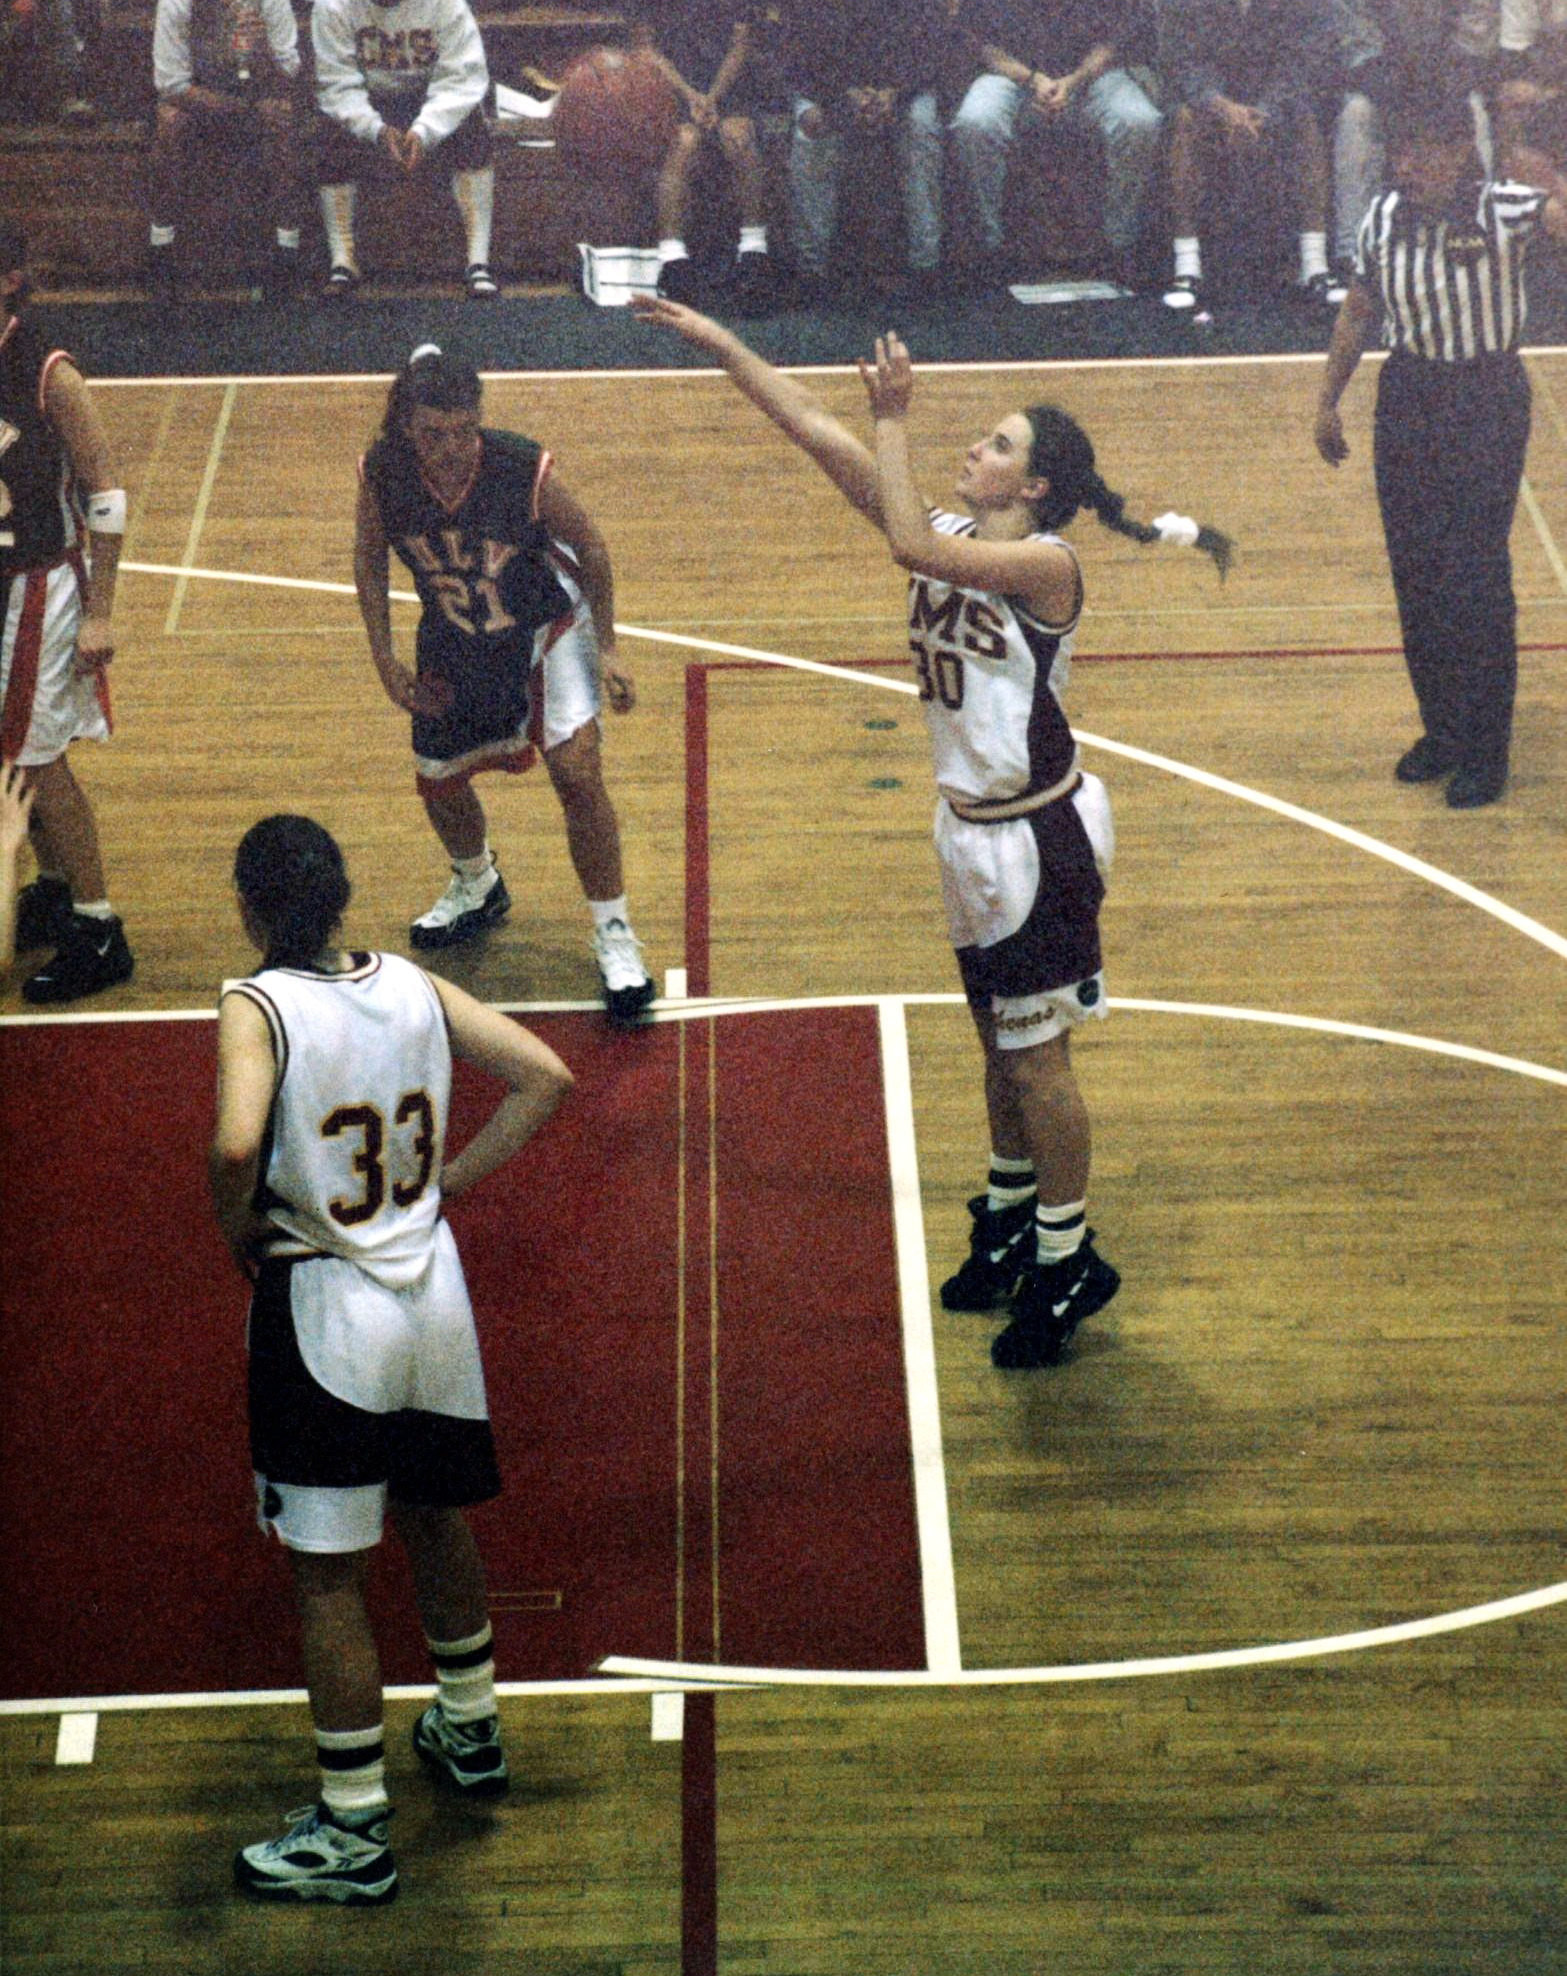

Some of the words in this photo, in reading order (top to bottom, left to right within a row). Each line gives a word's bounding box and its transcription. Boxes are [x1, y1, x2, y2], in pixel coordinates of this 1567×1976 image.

[355, 26, 439, 70] CMS
[429, 573, 517, 635] 21
[909, 577, 1007, 661] MS
[909, 639, 964, 711] 30
[320, 1087, 440, 1229] 33
